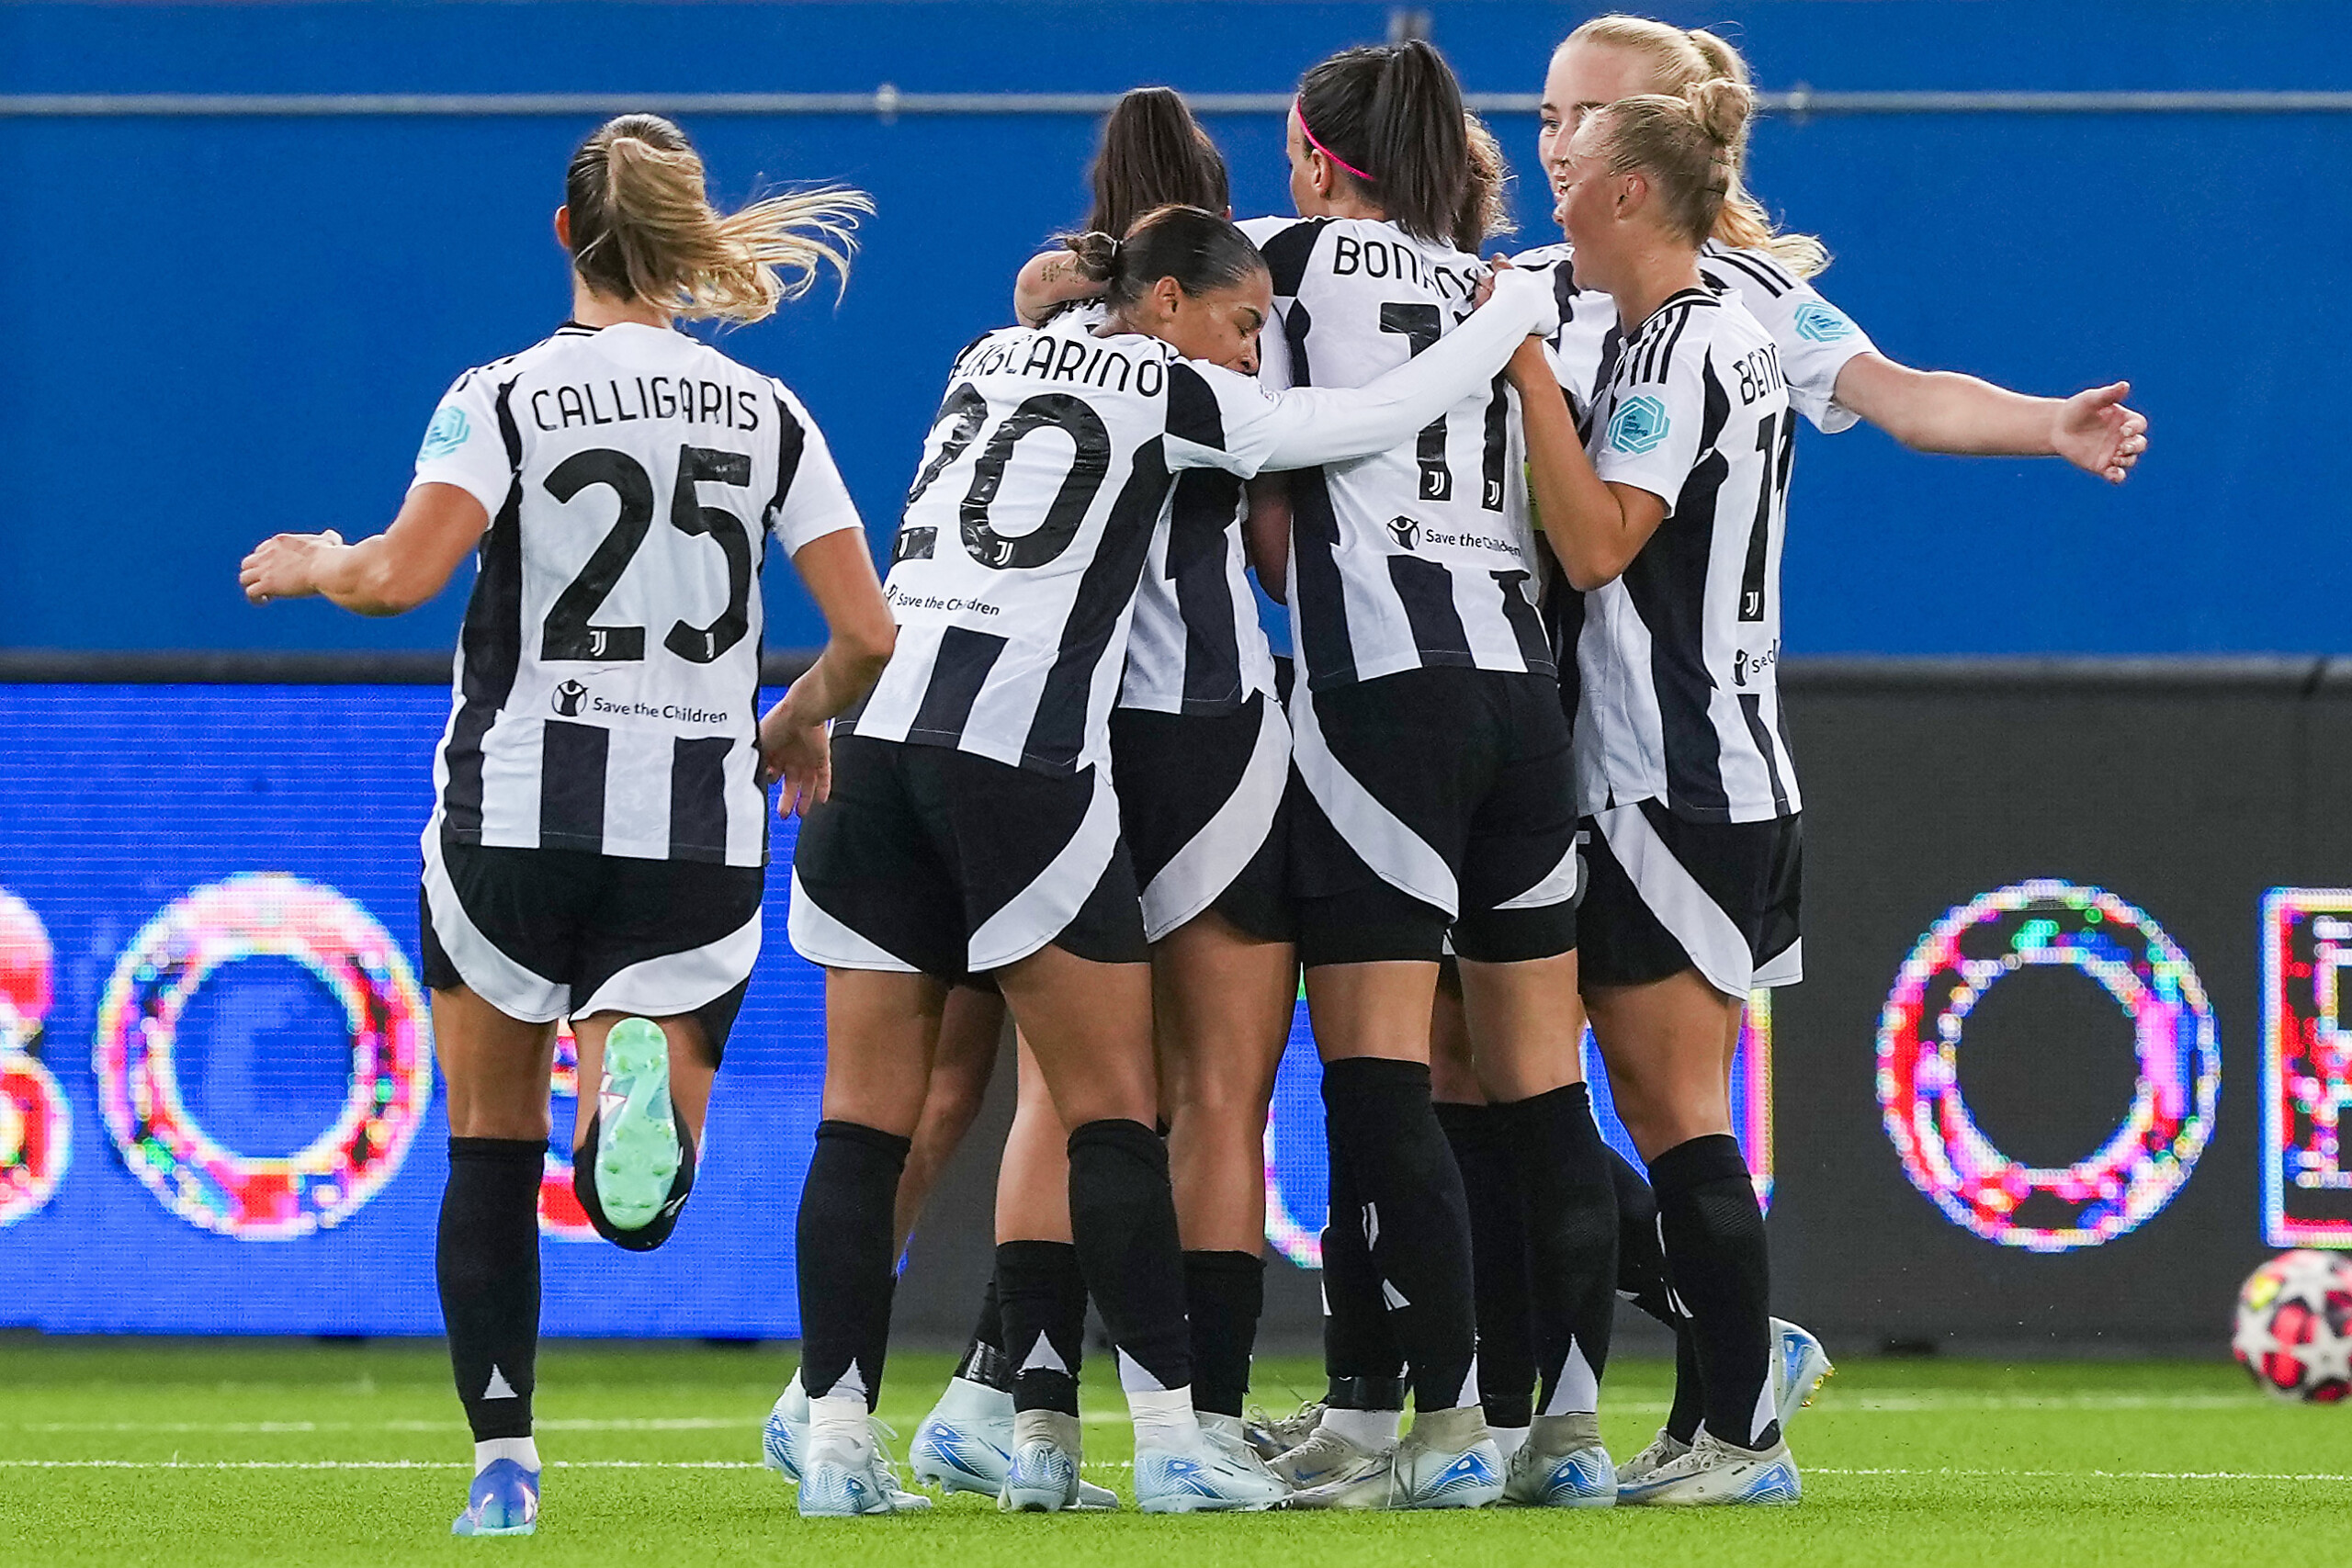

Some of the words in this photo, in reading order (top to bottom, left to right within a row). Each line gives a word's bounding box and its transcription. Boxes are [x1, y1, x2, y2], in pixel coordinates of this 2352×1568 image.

[531, 377, 759, 431] CALLIGARIS
[891, 382, 1111, 570] 20
[540, 444, 752, 664] 25
[1426, 529, 1456, 545] Save
[1460, 533, 1482, 548] the
[897, 592, 923, 607] Save
[924, 596, 944, 610] the
[593, 697, 630, 716] Save
[634, 702, 659, 717] the
[662, 705, 728, 724] Children
